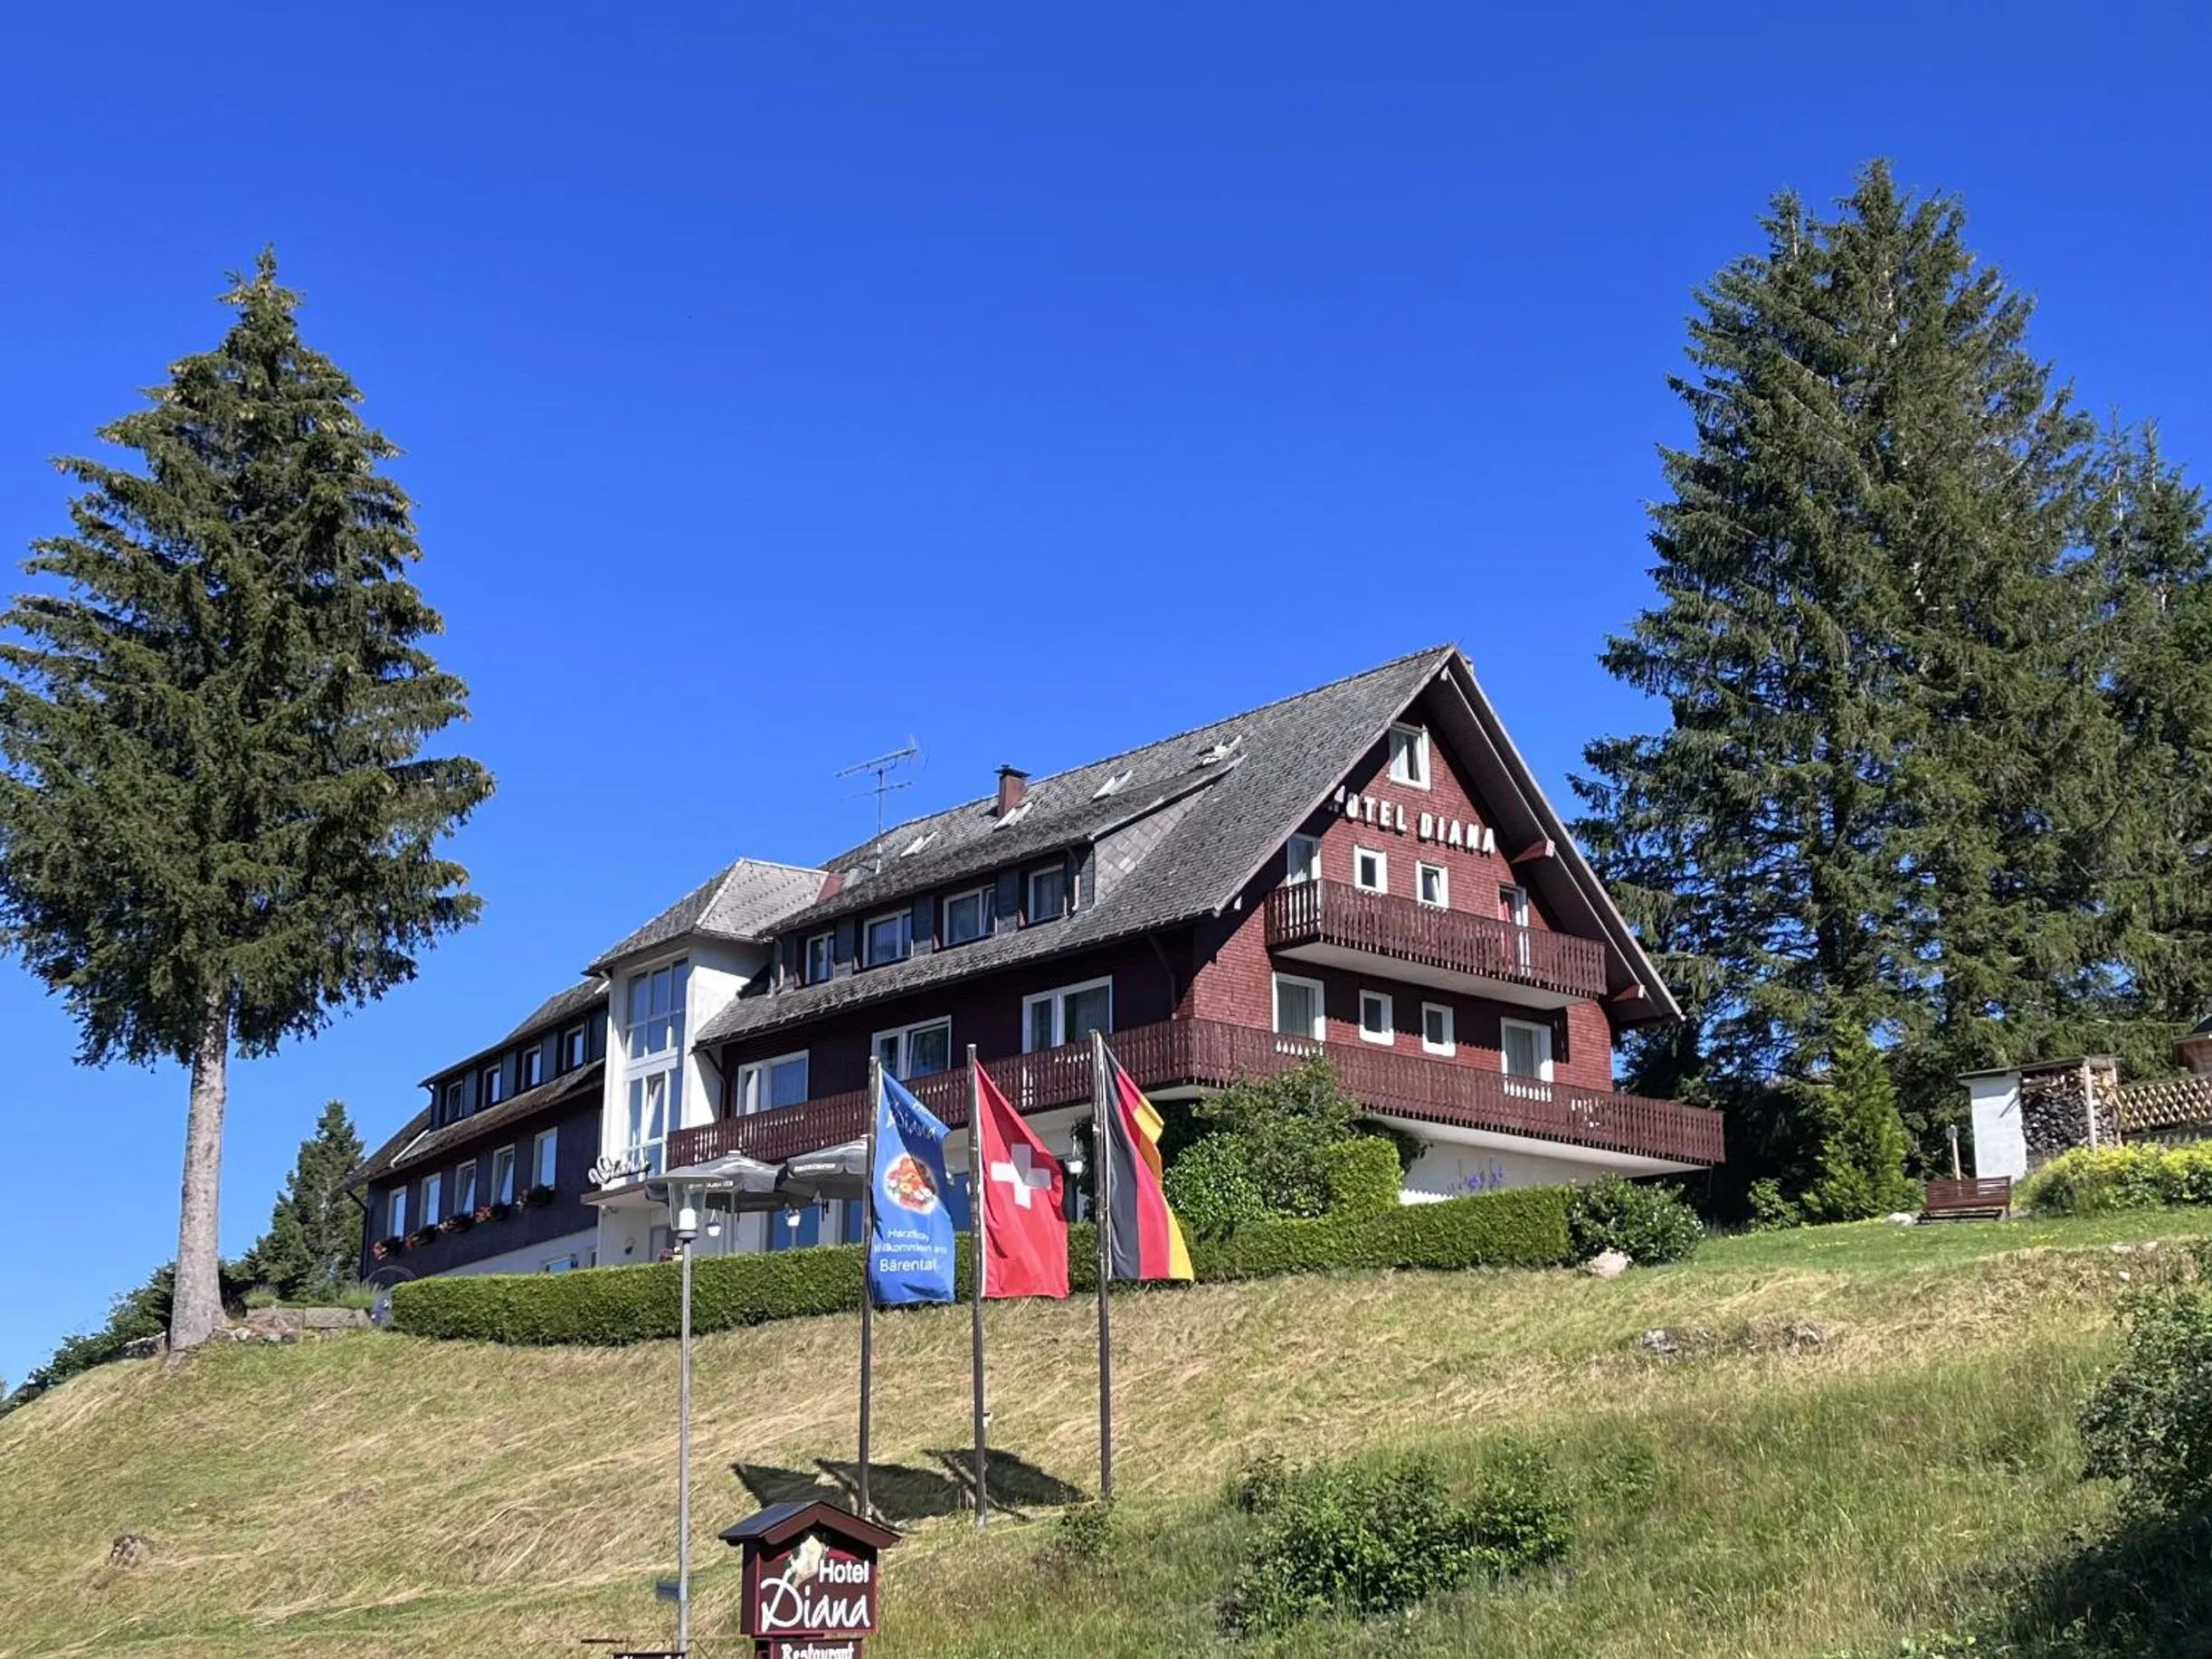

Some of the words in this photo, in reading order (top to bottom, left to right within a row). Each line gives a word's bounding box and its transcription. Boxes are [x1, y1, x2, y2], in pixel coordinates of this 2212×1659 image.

[1419, 812, 1495, 854] DIANA
[879, 1257, 937, 1273] Bärental
[819, 1559, 869, 1583] Hotel
[761, 1577, 870, 1633] Diana
